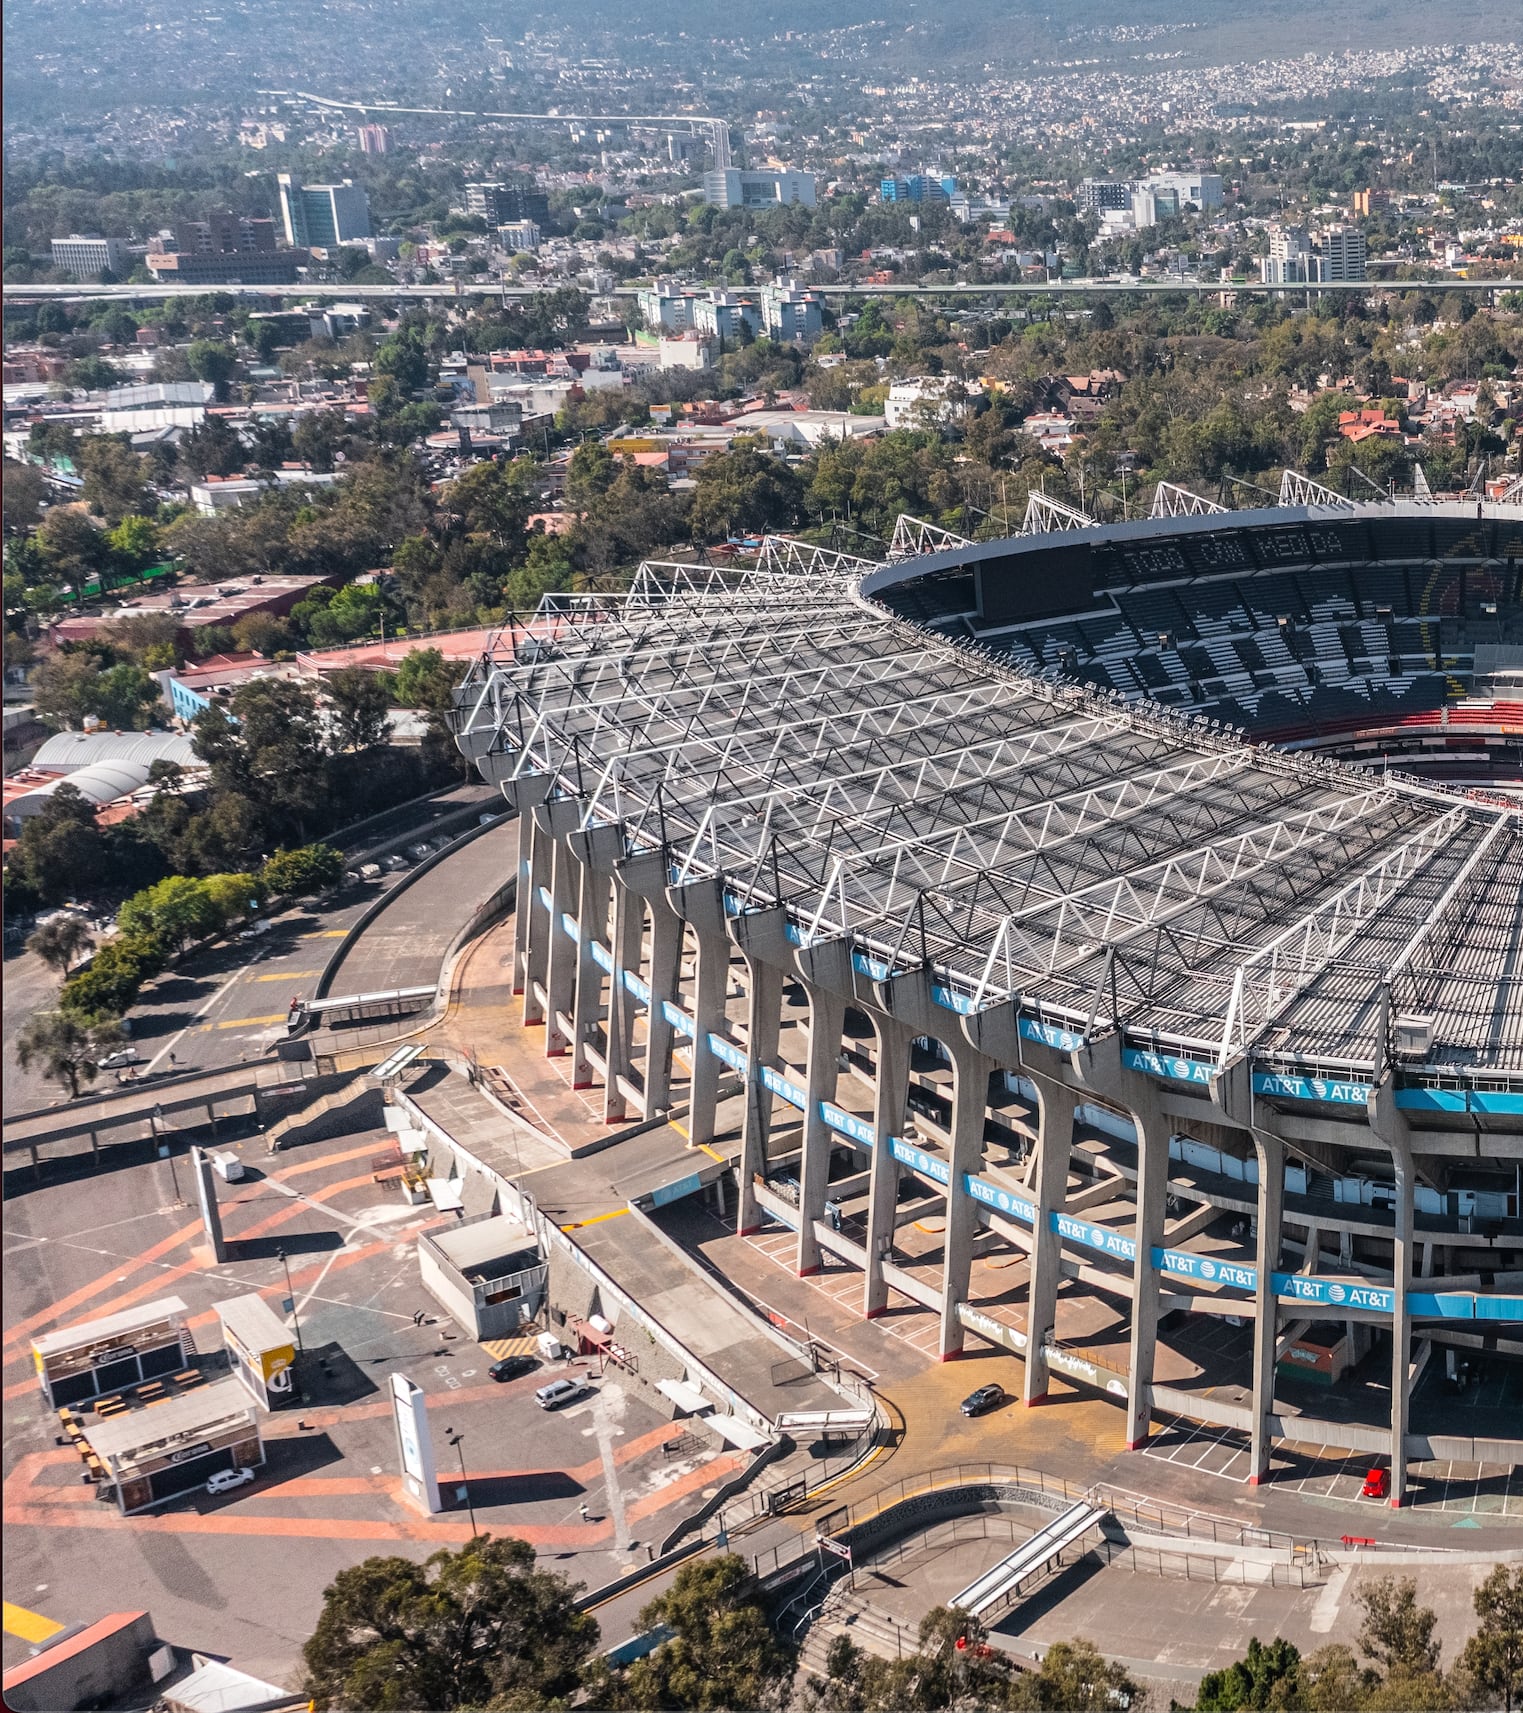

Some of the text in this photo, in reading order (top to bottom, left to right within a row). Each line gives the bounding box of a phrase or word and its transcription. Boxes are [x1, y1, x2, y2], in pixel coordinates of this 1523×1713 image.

[1133, 1052, 1168, 1076] AT&T
[764, 1072, 783, 1091] AT&T
[1262, 1077, 1370, 1102] AT&T AT&T
[825, 1109, 874, 1142] AT&T AT&
[894, 1144, 949, 1181] AT&T AT&
[970, 1181, 995, 1201] AT&T
[1058, 1219, 1136, 1257] AT&T AT&T
[1162, 1253, 1255, 1286] AT&T AT&T
[1284, 1280, 1390, 1308] AT&T AT&T
